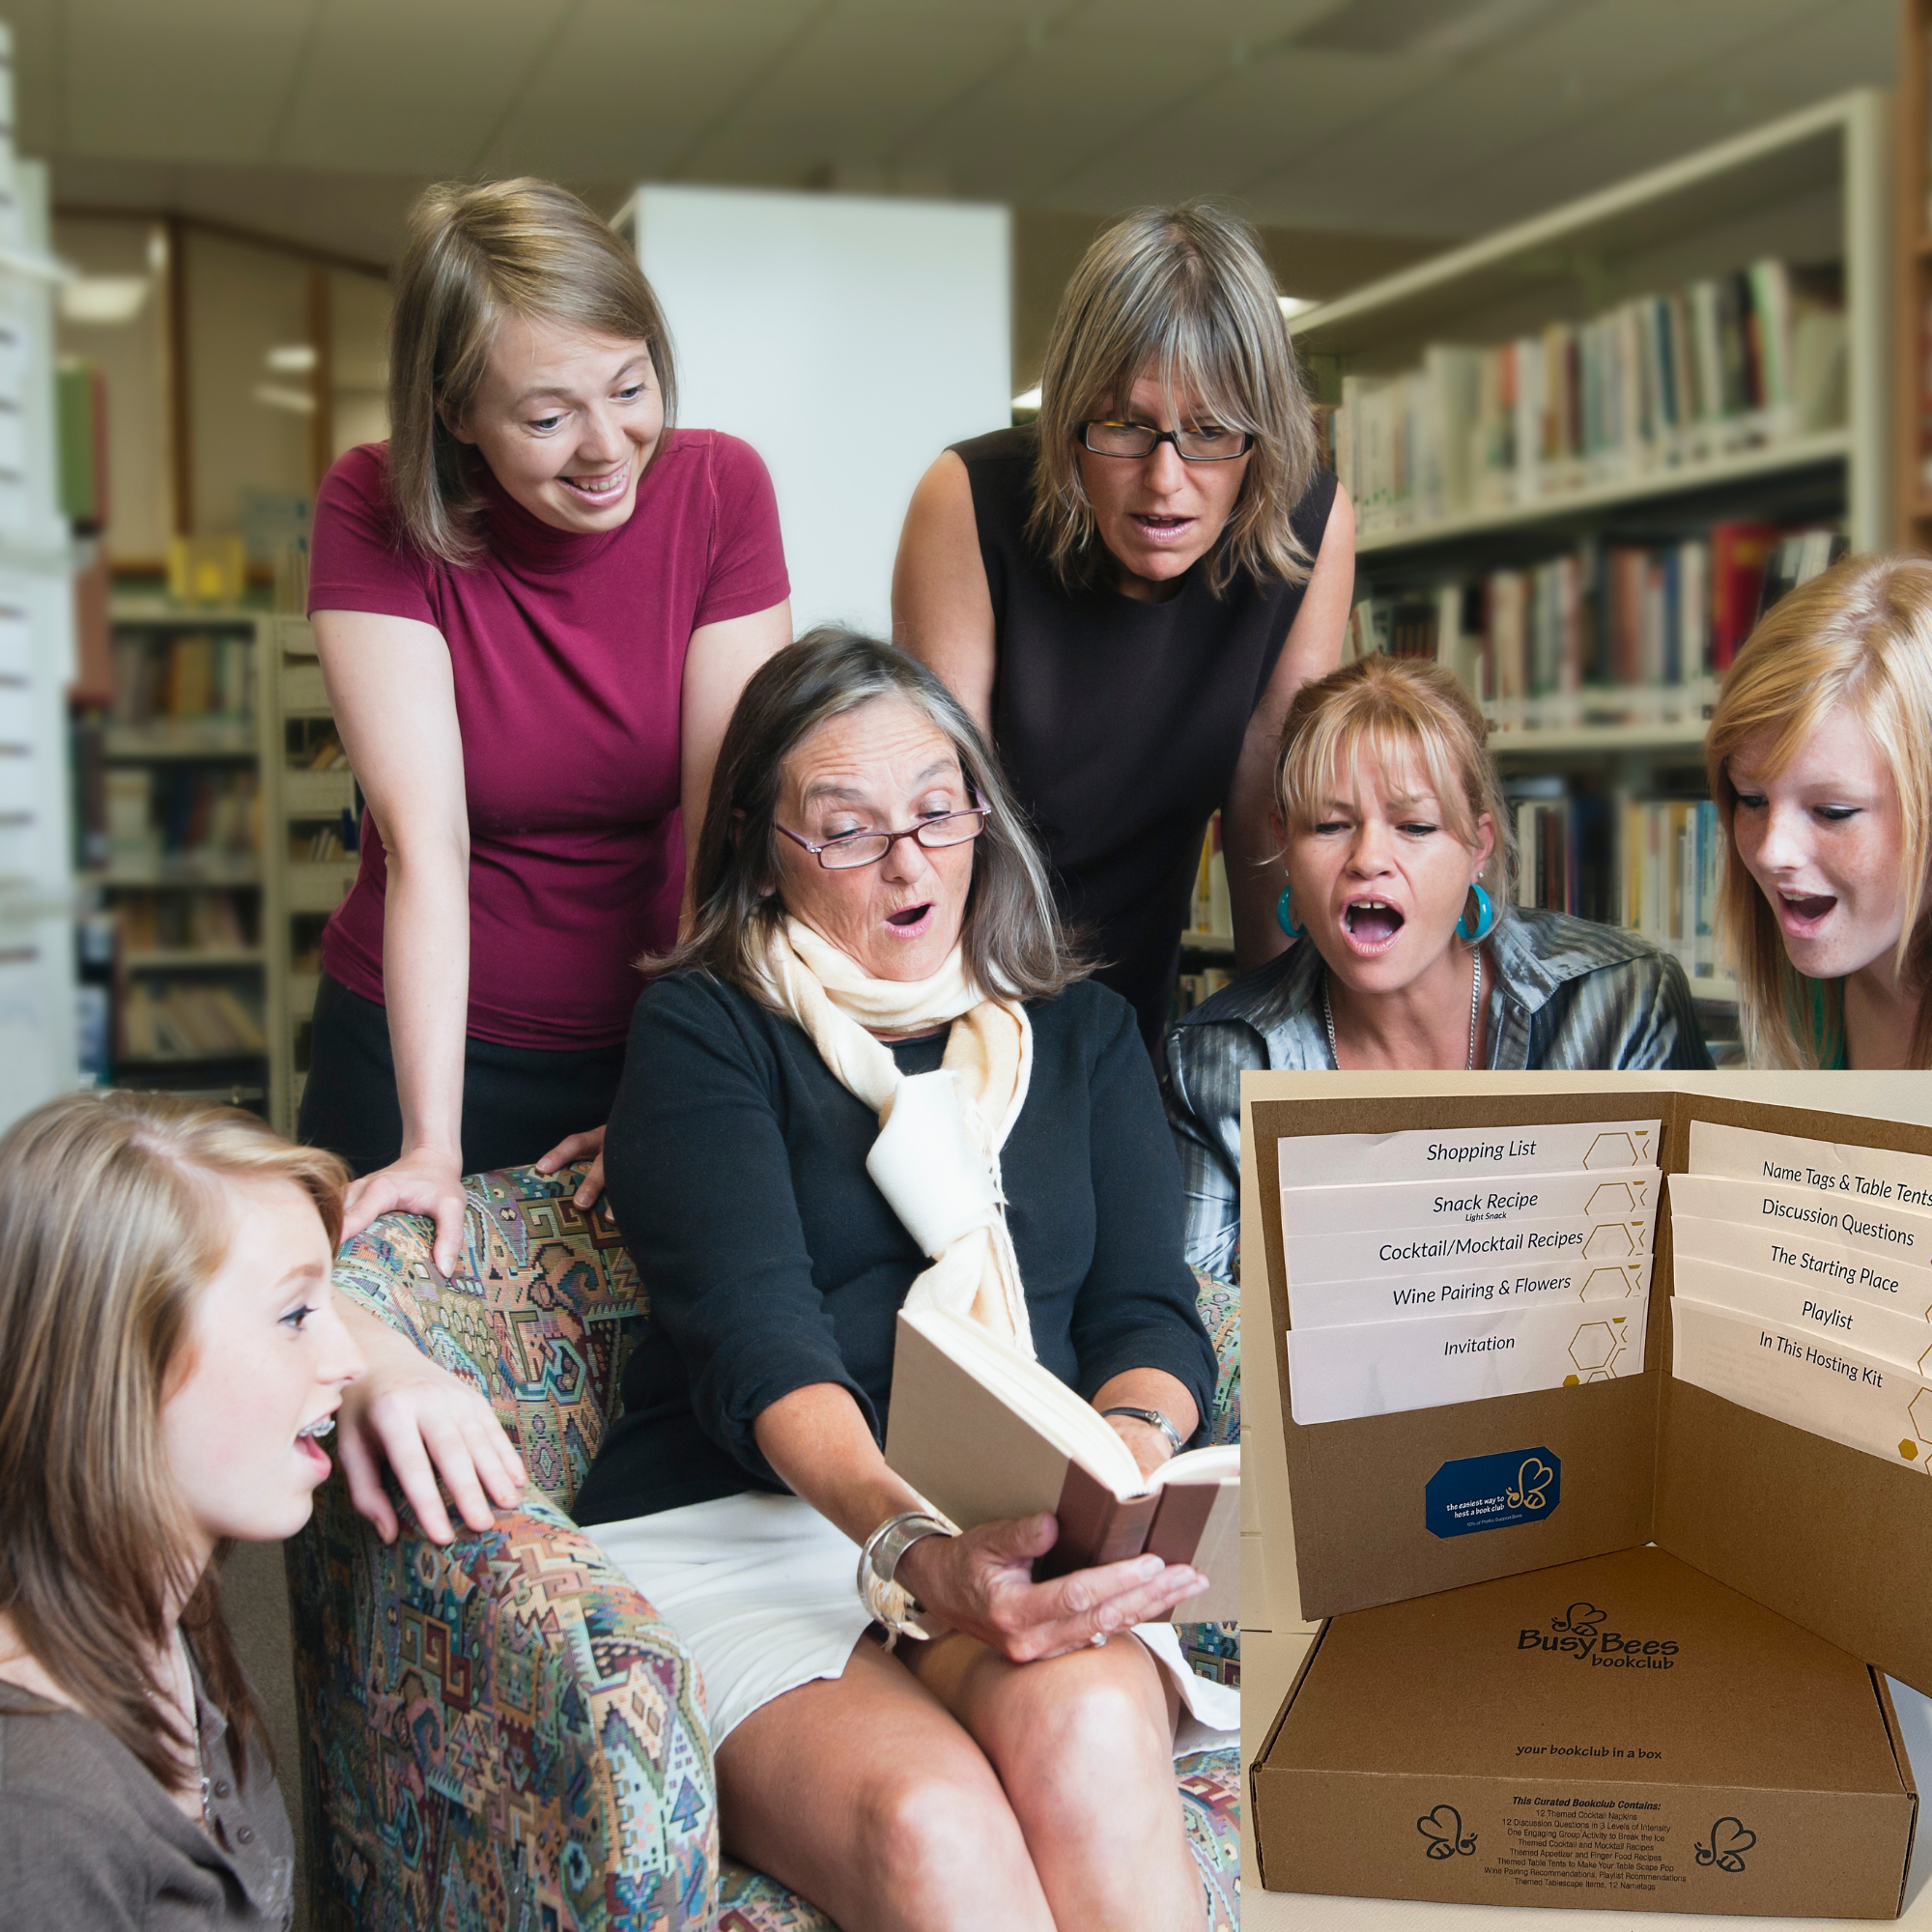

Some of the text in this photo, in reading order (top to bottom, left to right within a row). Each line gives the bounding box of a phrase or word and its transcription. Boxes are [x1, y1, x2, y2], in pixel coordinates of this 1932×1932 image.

[1427, 1140, 1537, 1162] Shopping List
[1763, 1161, 1932, 1207] Name Tags & Table Tents
[1433, 1192, 1538, 1212] Snack Recipe
[1465, 1211, 1507, 1222] Light Snack
[1762, 1198, 1915, 1246] Discussion Questions
[1378, 1231, 1583, 1261] Cocktail/Mocktail Recipes
[1771, 1245, 1899, 1293] The Starting Place
[1393, 1276, 1572, 1305] Wine Pairing & Flowers
[1802, 1300, 1854, 1329] Playlist
[1444, 1336, 1515, 1355] Invitation
[1759, 1331, 1884, 1388] In This Hosting Kit
[1446, 1503, 1459, 1512] the
[1459, 1498, 1483, 1510] easiest
[1484, 1497, 1496, 1506] way
[1454, 1510, 1470, 1519] host
[1475, 1505, 1492, 1515] book
[1491, 1503, 1505, 1512] club
[1517, 1629, 1680, 1660] Busy Bees
[1591, 1653, 1674, 1669] bookclub
[1515, 1745, 1662, 1759] your bookclub in a box
[1513, 1796, 1662, 1810] This Curated Bookclub Contains:
[1547, 1809, 1577, 1818] Themed
[1608, 1812, 1637, 1821] Napkins
[1514, 1818, 1552, 1828] Discussion
[1553, 1820, 1589, 1829] Questions
[1606, 1822, 1630, 1831] Levels
[1640, 1824, 1671, 1833] Intensity
[1507, 1828, 1522, 1836] One
[1523, 1829, 1557, 1838] Engaging
[1558, 1831, 1580, 1839] Group
[1582, 1832, 1607, 1840] Activity
[1618, 1833, 1639, 1841] Break
[1518, 1838, 1548, 1847] Themed
[1548, 1839, 1577, 1848] Cocktail
[1594, 1841, 1624, 1850] Mocktail
[1626, 1842, 1655, 1852] Recipes
[1541, 1849, 1573, 1858] Appetizer
[1590, 1851, 1612, 1861] Finger
[1634, 1853, 1662, 1861] Recipes
[1497, 1857, 1526, 1865] Themed
[1635, 1862, 1659, 1872] Scape
[1660, 1863, 1674, 1872] Pop
